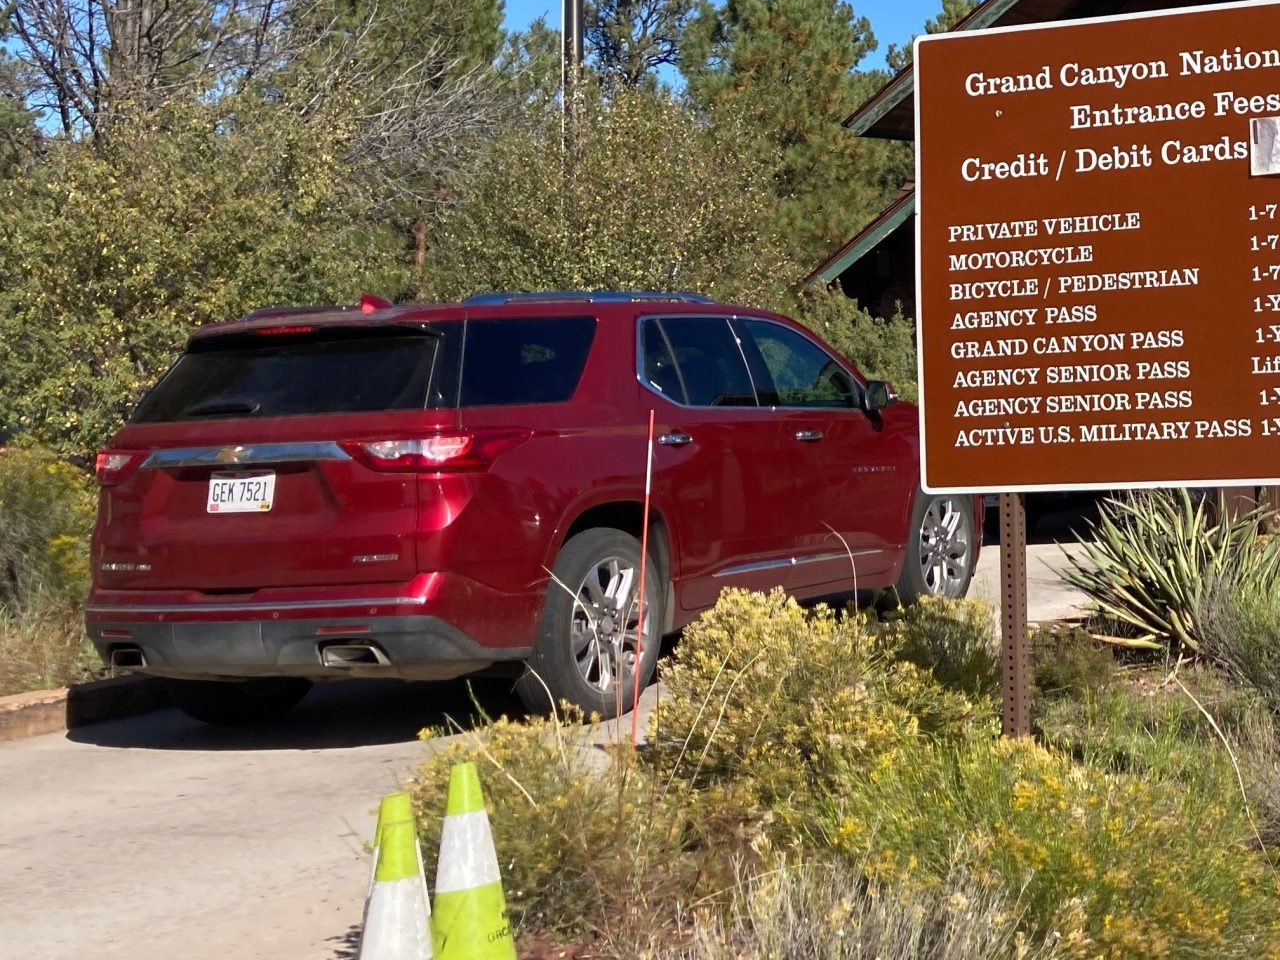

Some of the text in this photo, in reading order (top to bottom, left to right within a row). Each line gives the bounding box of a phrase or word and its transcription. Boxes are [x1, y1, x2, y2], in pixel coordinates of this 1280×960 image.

[965, 66, 1053, 96] Grand
[1060, 61, 1168, 88] Canyon
[1070, 92, 1280, 129] Entrance Fees
[962, 153, 1048, 181] Credit
[1056, 151, 1066, 181] /
[1075, 145, 1152, 172] Debit
[1161, 136, 1248, 164] Cards
[949, 220, 1037, 242] PRIVATE
[1043, 213, 1140, 234] VEHICLE
[1249, 204, 1277, 220] 1-7
[949, 246, 1092, 271] MOTORCYCLE
[1251, 235, 1279, 250] 1-7
[950, 279, 1038, 300] BICYCLE
[1044, 278, 1050, 299] /
[1058, 268, 1199, 293] PEDESTRIAN
[1253, 265, 1280, 281] 1-7
[950, 309, 1038, 329] AGENCY
[1045, 305, 1097, 324] PASS
[951, 339, 1028, 358] GRAND
[1033, 333, 1125, 354] CANYON
[1131, 330, 1184, 349] PASS
[953, 368, 1040, 387] AGENCY
[1047, 364, 1131, 383] SENIOR
[1136, 361, 1190, 379] PASS
[954, 397, 1042, 417] AGENCY
[1047, 394, 1131, 412] SENIOR
[1135, 391, 1192, 409] PASS
[955, 428, 1034, 447] ACTIVE
[1038, 426, 1075, 443] U.S.
[1079, 422, 1190, 442] MILITARY
[1195, 419, 1251, 438] PASS
[212, 481, 268, 503] GEK 7521
